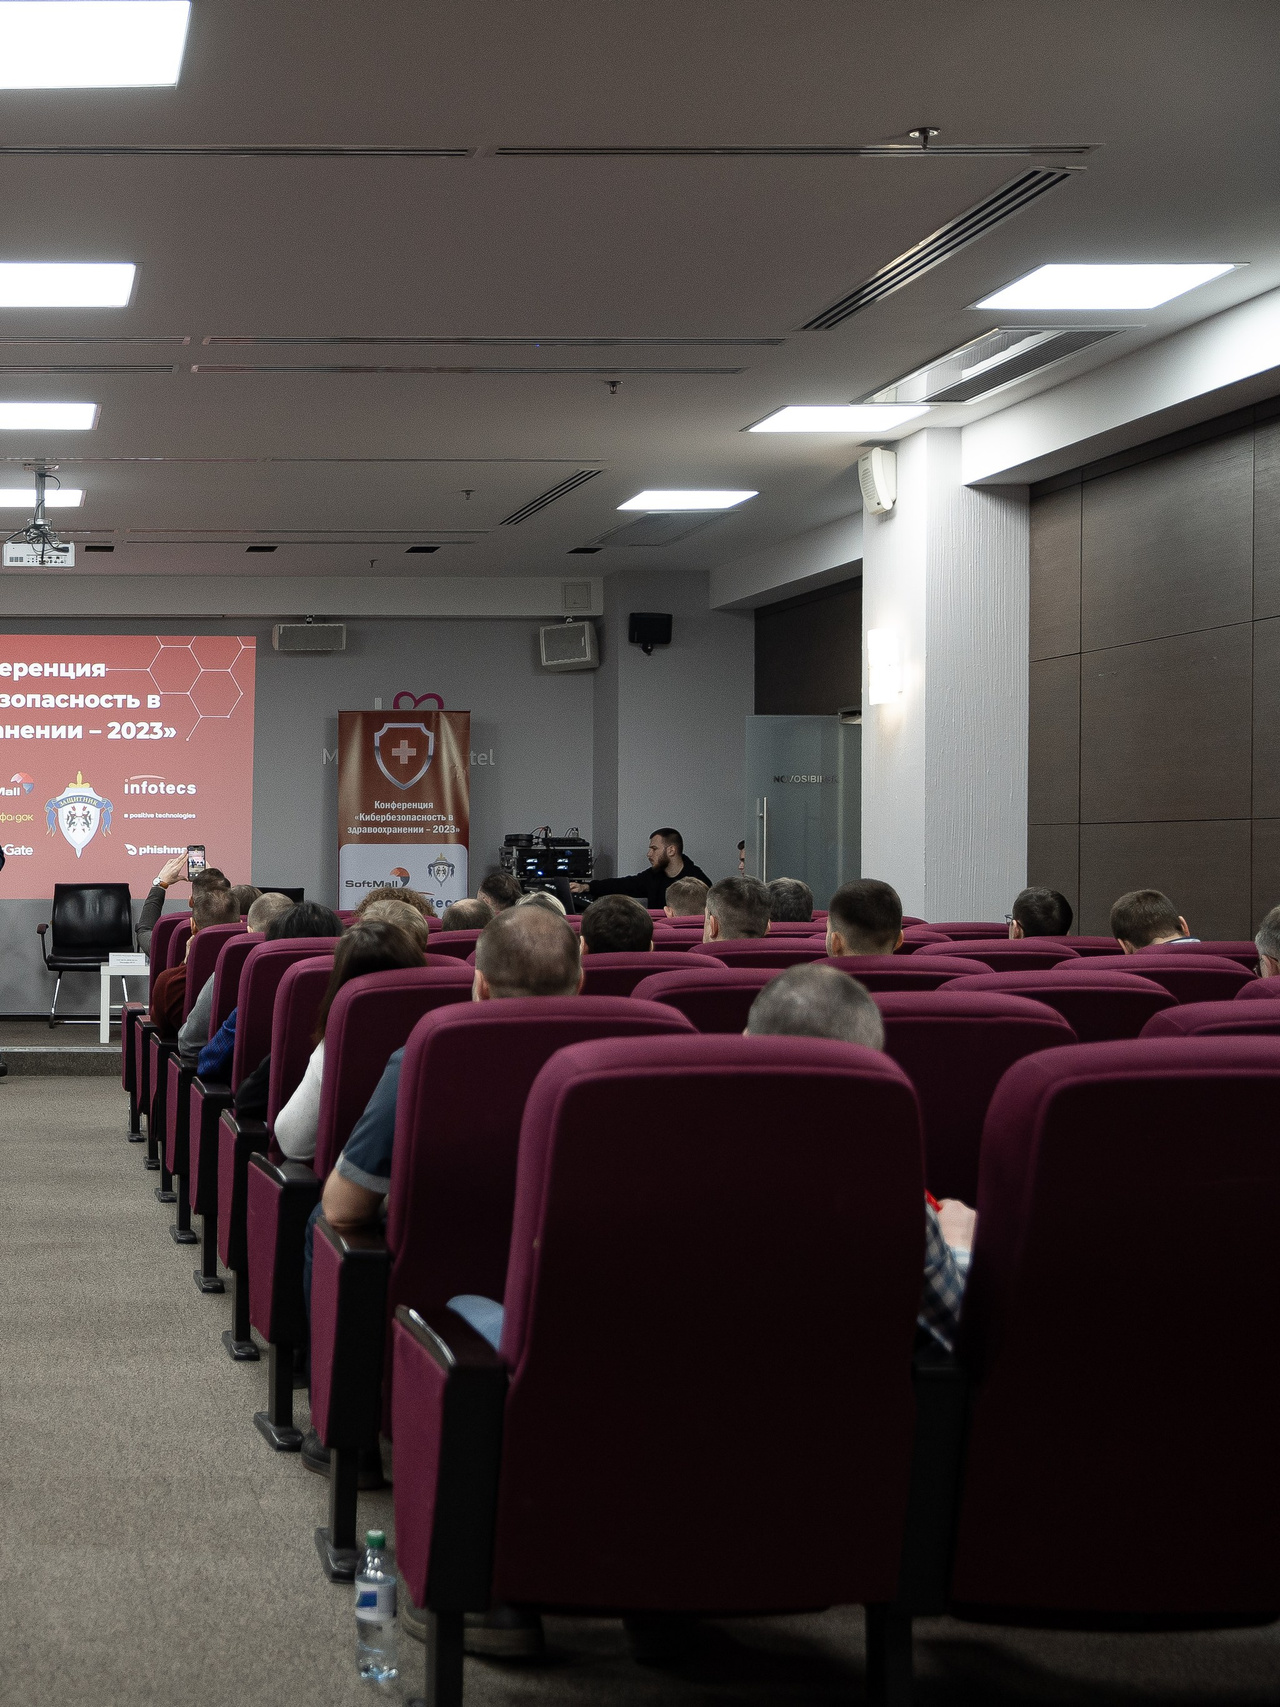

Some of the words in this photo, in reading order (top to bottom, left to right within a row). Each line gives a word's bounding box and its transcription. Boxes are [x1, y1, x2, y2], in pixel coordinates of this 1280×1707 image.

[147, 695, 161, 708] в
[107, 721, 177, 740] 2023»
[124, 779, 197, 795] infotecs
[374, 801, 434, 810] Конференция
[155, 812, 196, 820] technologies
[354, 813, 446, 823] «Кибербезопасность
[347, 826, 424, 835] здравоохранении
[432, 825, 460, 834] 2023»
[345, 880, 398, 888] SoftMall
